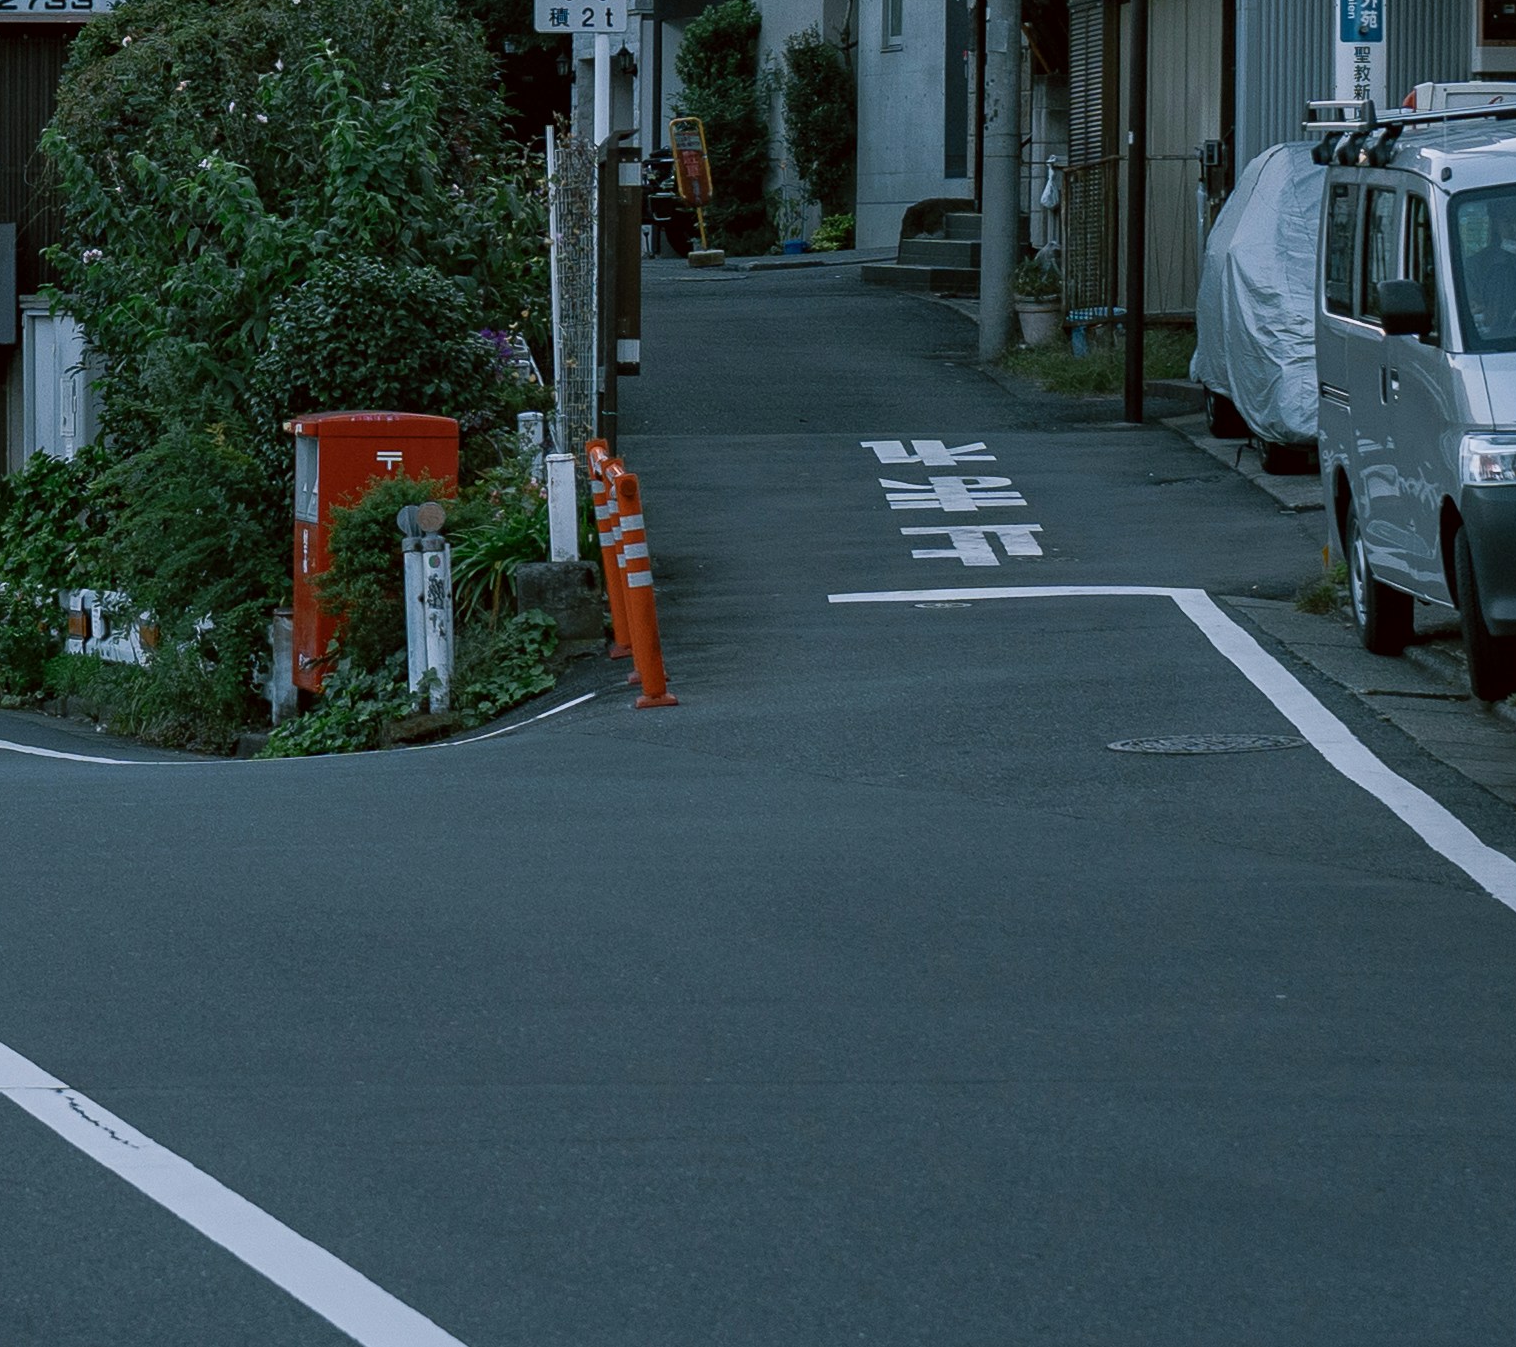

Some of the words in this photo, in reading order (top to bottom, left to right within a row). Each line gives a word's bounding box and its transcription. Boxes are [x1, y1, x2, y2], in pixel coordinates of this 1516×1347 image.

[1353, 46, 1371, 118] 聖教新
[860, 439, 1044, 567] 止まれ
